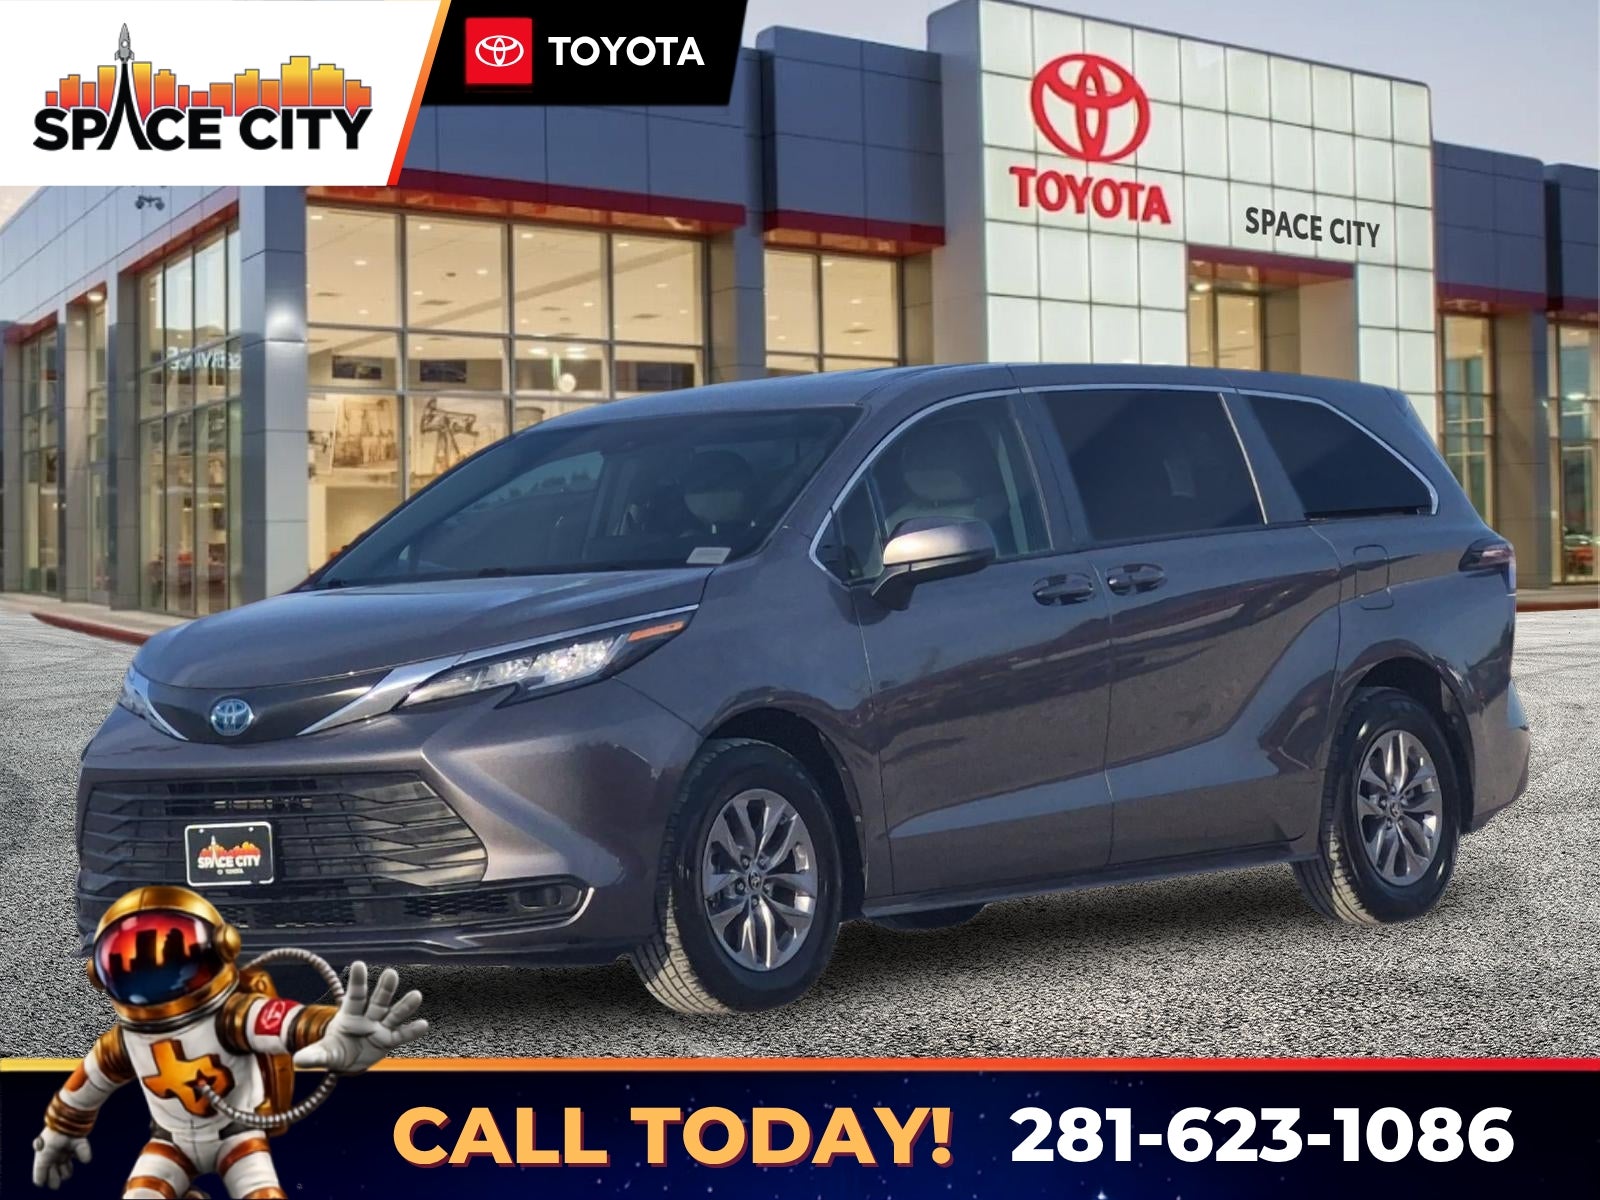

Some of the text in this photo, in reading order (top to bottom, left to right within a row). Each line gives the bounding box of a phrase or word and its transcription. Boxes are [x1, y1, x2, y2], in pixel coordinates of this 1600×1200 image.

[1009, 165, 1171, 225] TOYOTA
[1245, 206, 1381, 248] SPACE CITY
[198, 848, 261, 868] SPACE CITY
